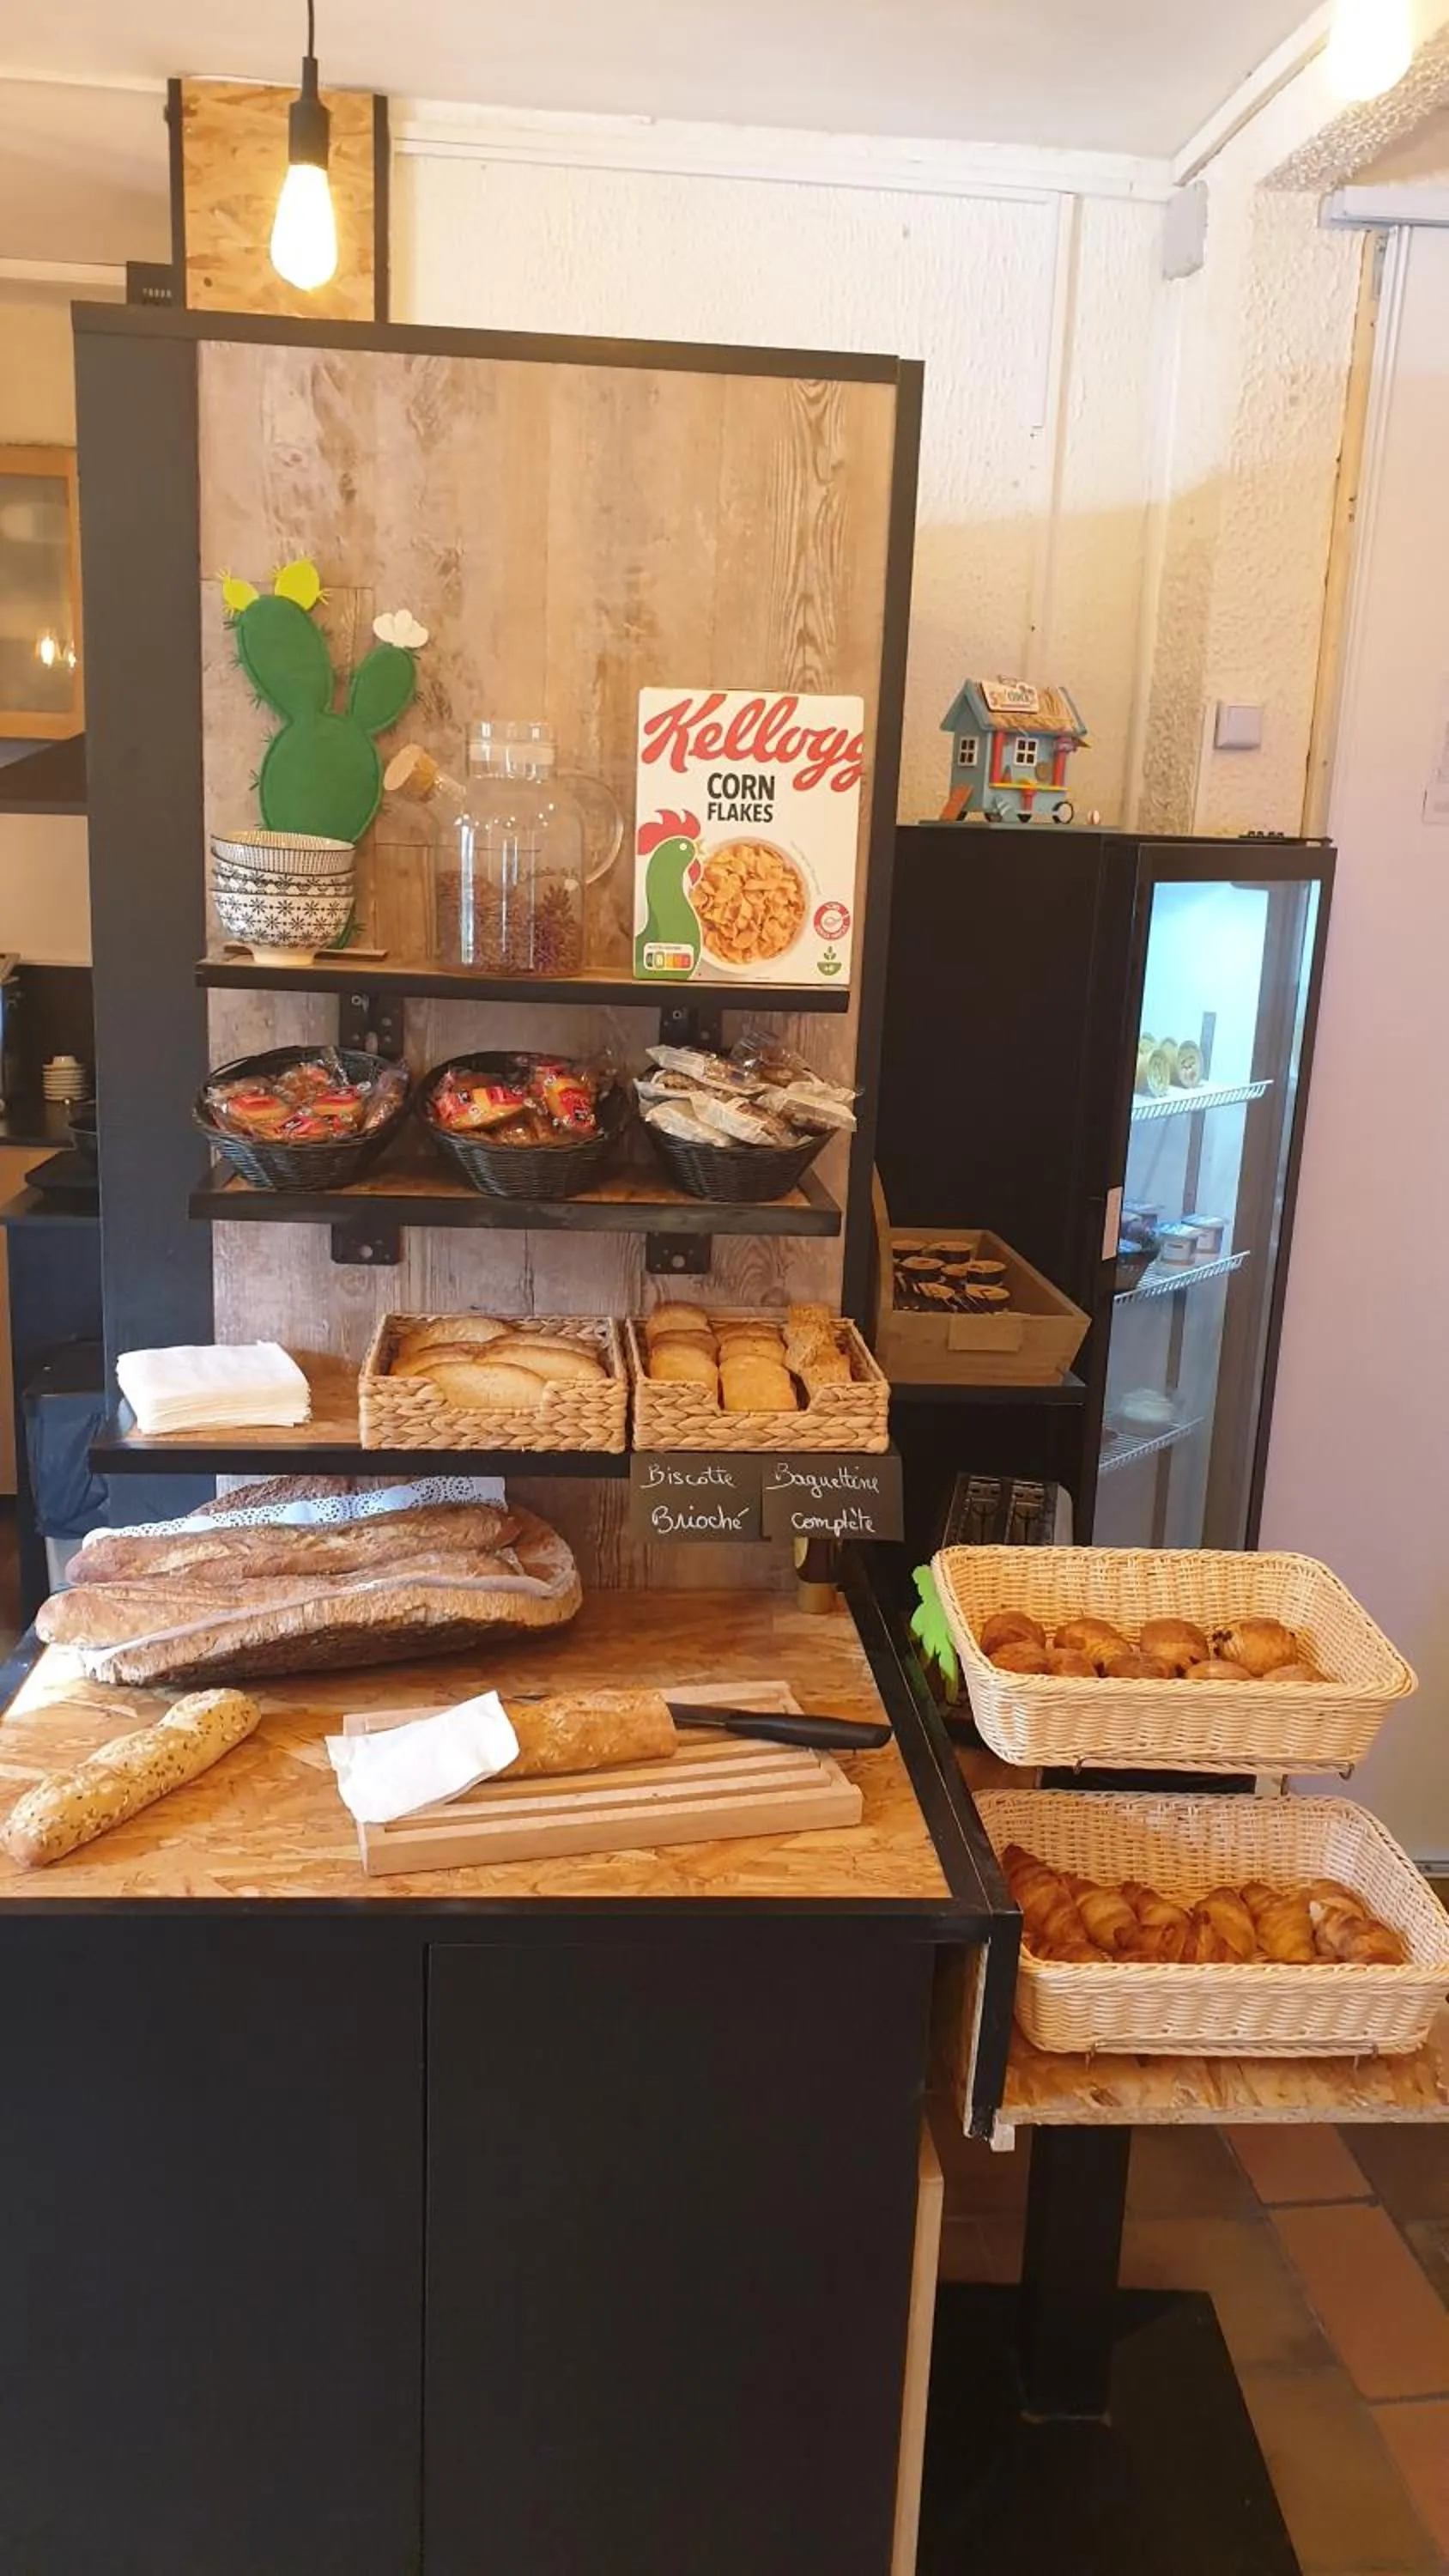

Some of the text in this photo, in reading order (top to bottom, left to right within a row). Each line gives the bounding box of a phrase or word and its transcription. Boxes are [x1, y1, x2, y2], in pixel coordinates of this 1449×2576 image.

[707, 773, 775, 801] CORN
[707, 802, 773, 823] FLAKES
[640, 1462, 737, 1488] Biscotte
[652, 1505, 749, 1534] Brioché
